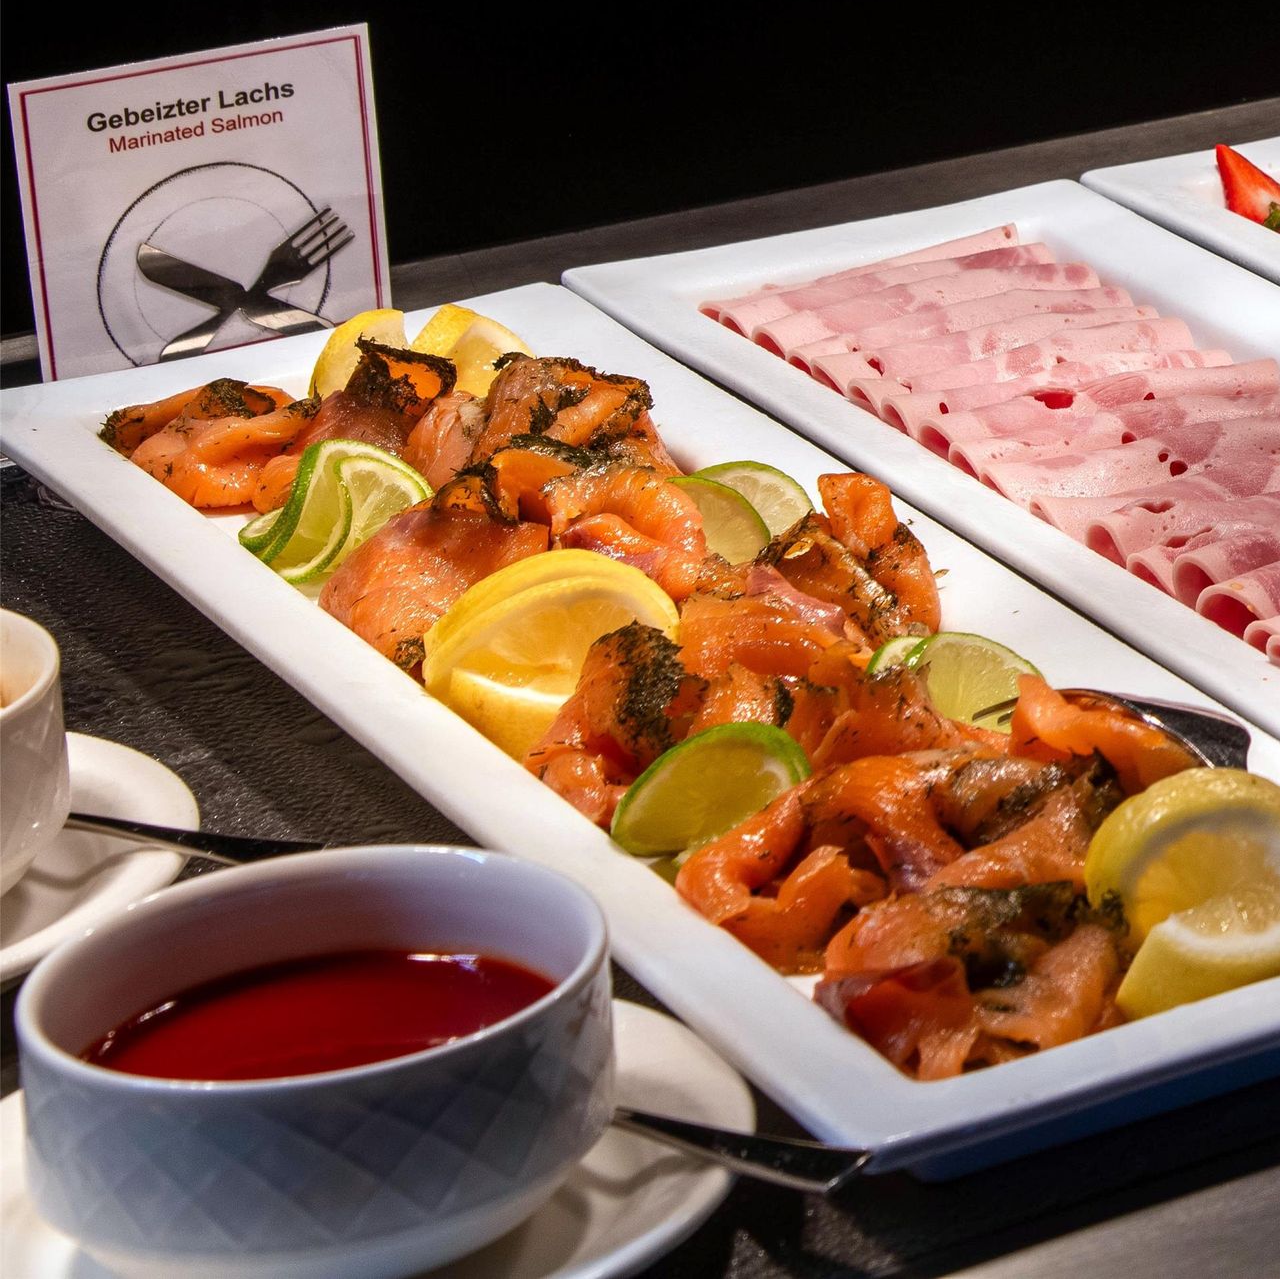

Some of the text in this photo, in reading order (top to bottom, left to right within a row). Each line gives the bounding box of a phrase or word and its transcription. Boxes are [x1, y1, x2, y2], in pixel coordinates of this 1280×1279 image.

[87, 82, 295, 132] Gebeizter Lachs
[109, 110, 284, 153] Marinated Salmon
